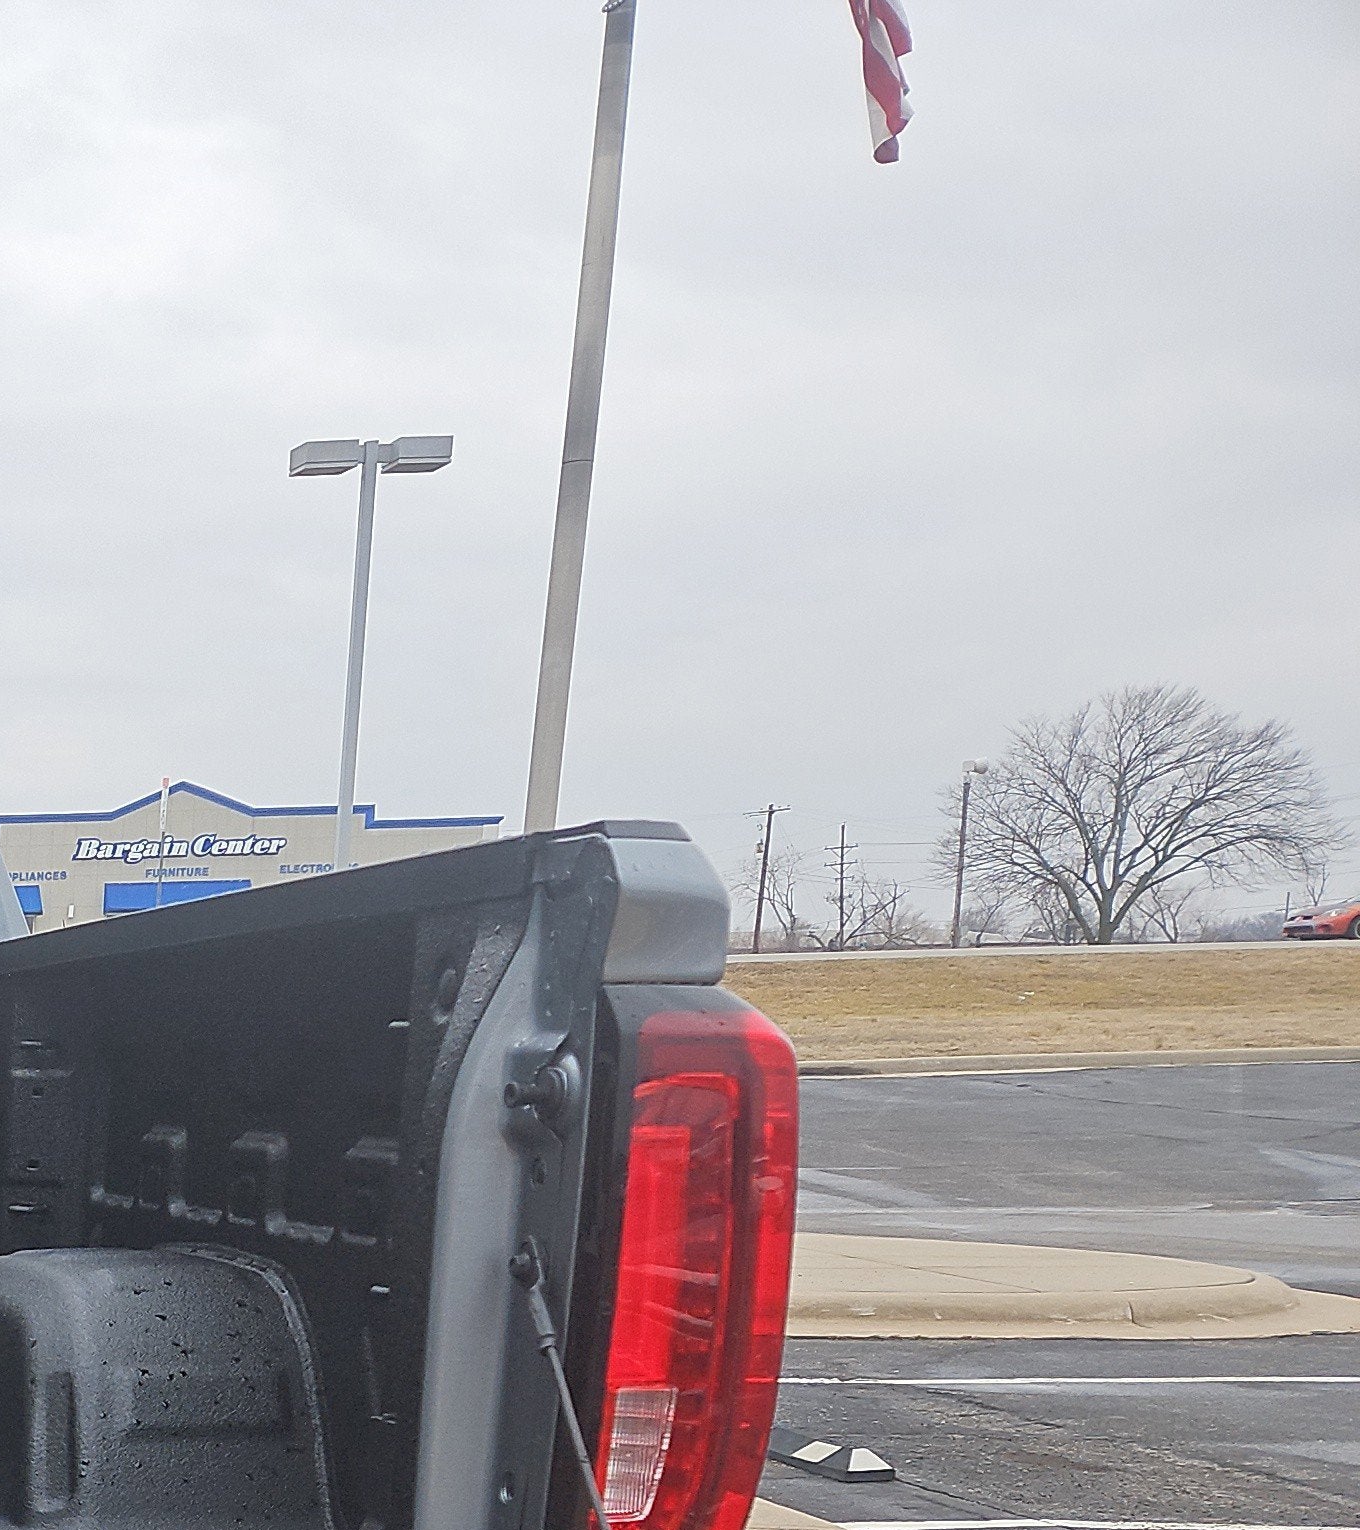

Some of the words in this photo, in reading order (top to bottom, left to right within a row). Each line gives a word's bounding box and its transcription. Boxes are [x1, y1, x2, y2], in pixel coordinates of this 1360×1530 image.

[73, 836, 188, 864] Bargain
[191, 834, 287, 857] Center
[145, 867, 209, 878] FURNITURE
